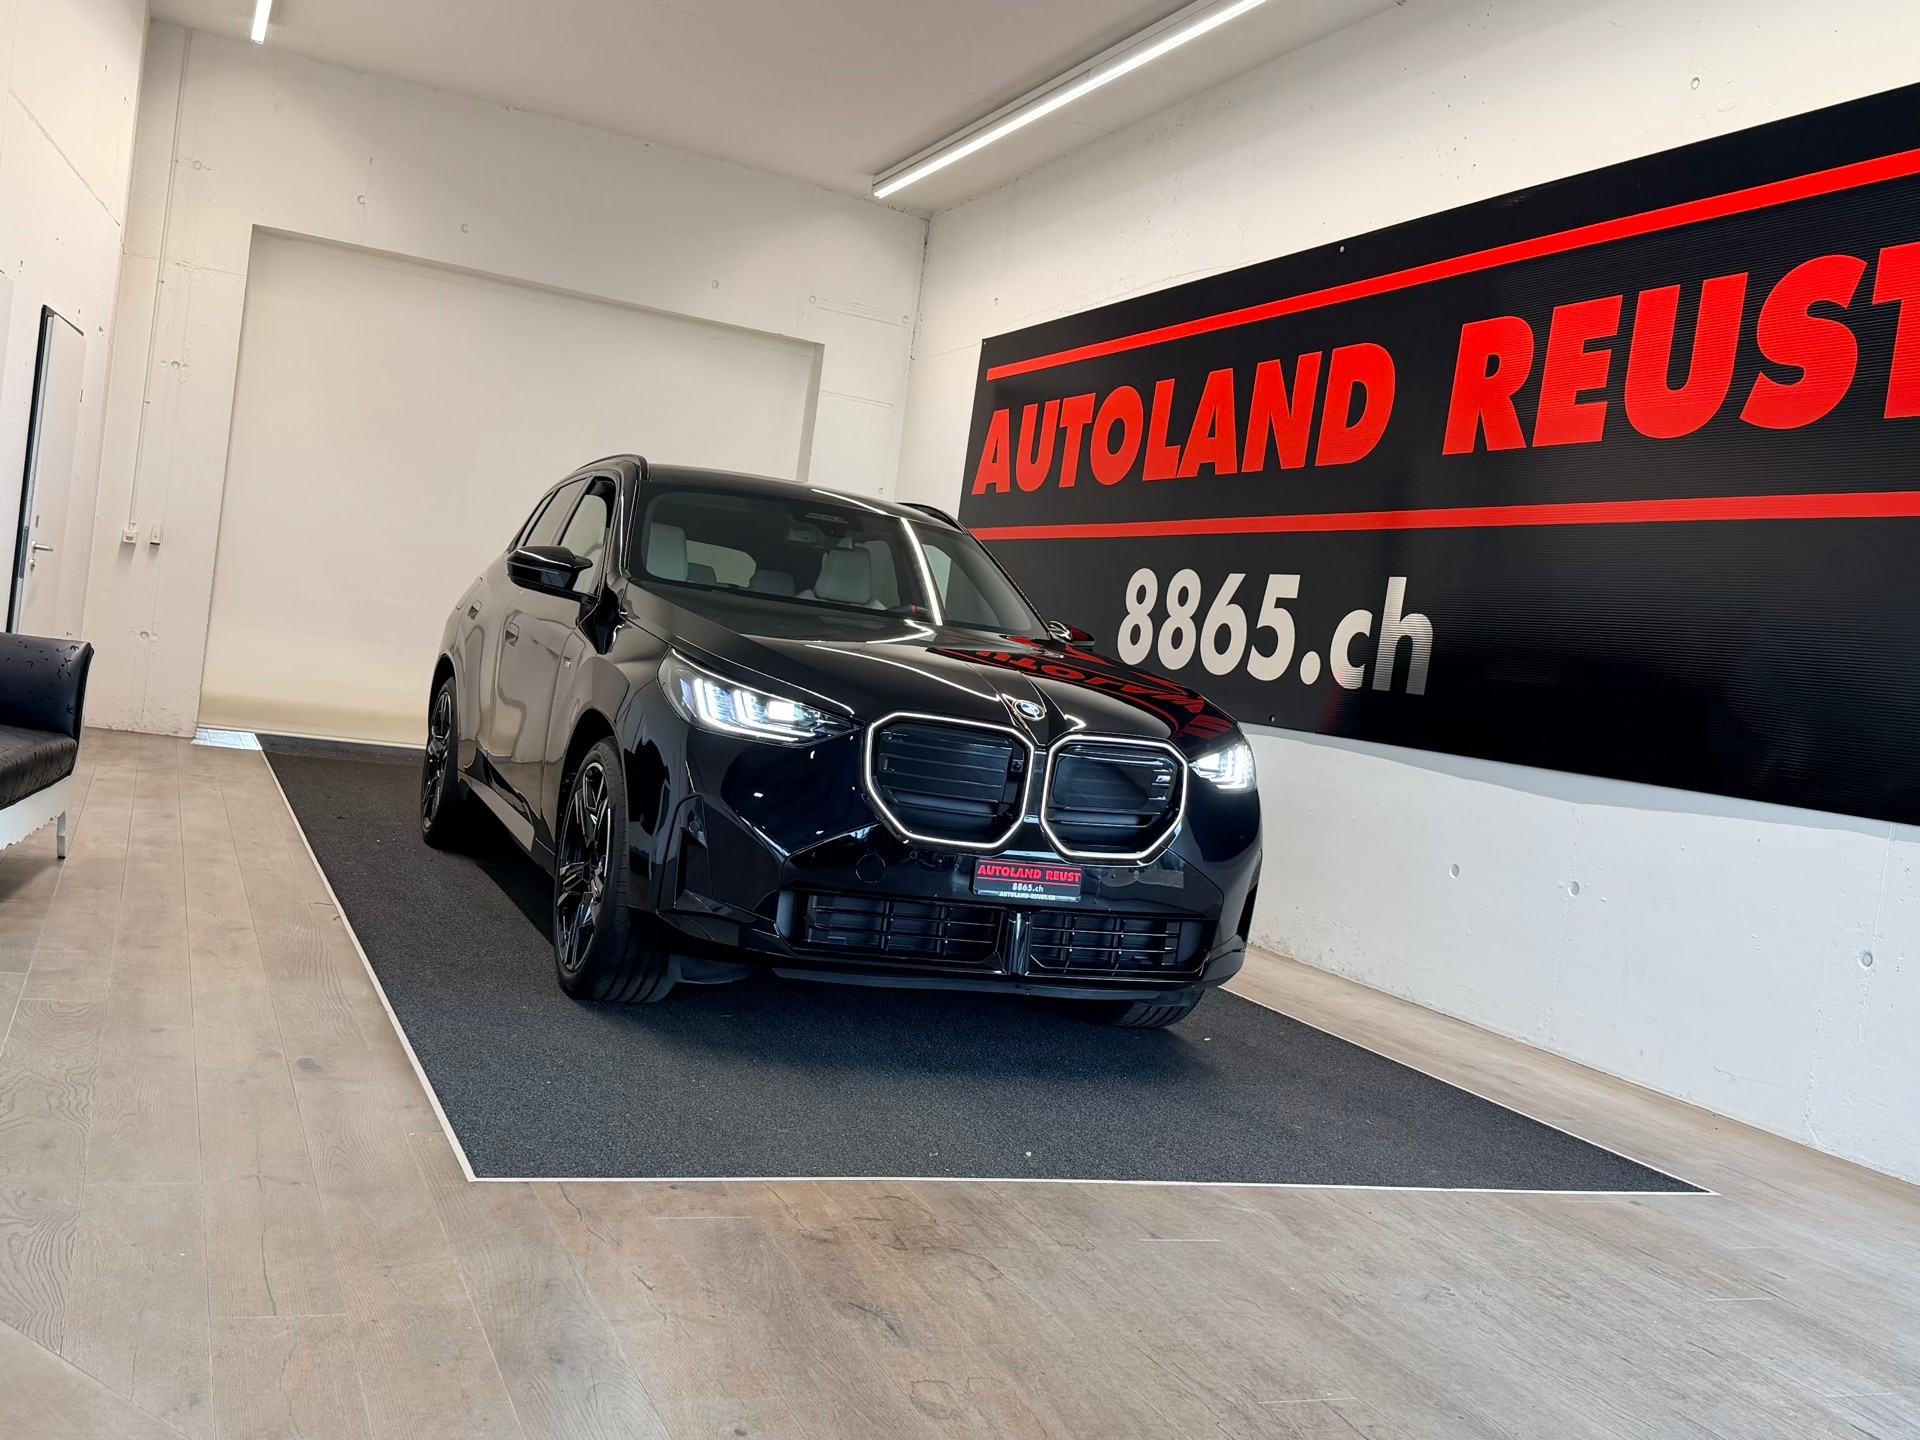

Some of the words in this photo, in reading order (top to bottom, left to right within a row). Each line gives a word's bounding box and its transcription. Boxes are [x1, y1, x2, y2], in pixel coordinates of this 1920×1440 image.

[972, 343, 1396, 496] AUTOLAND
[1117, 567, 1434, 696] 8865.ch
[978, 865, 1042, 879] AUTOLAND
[1046, 870, 1082, 882] REUST
[1012, 882, 1044, 893] 8865.ch
